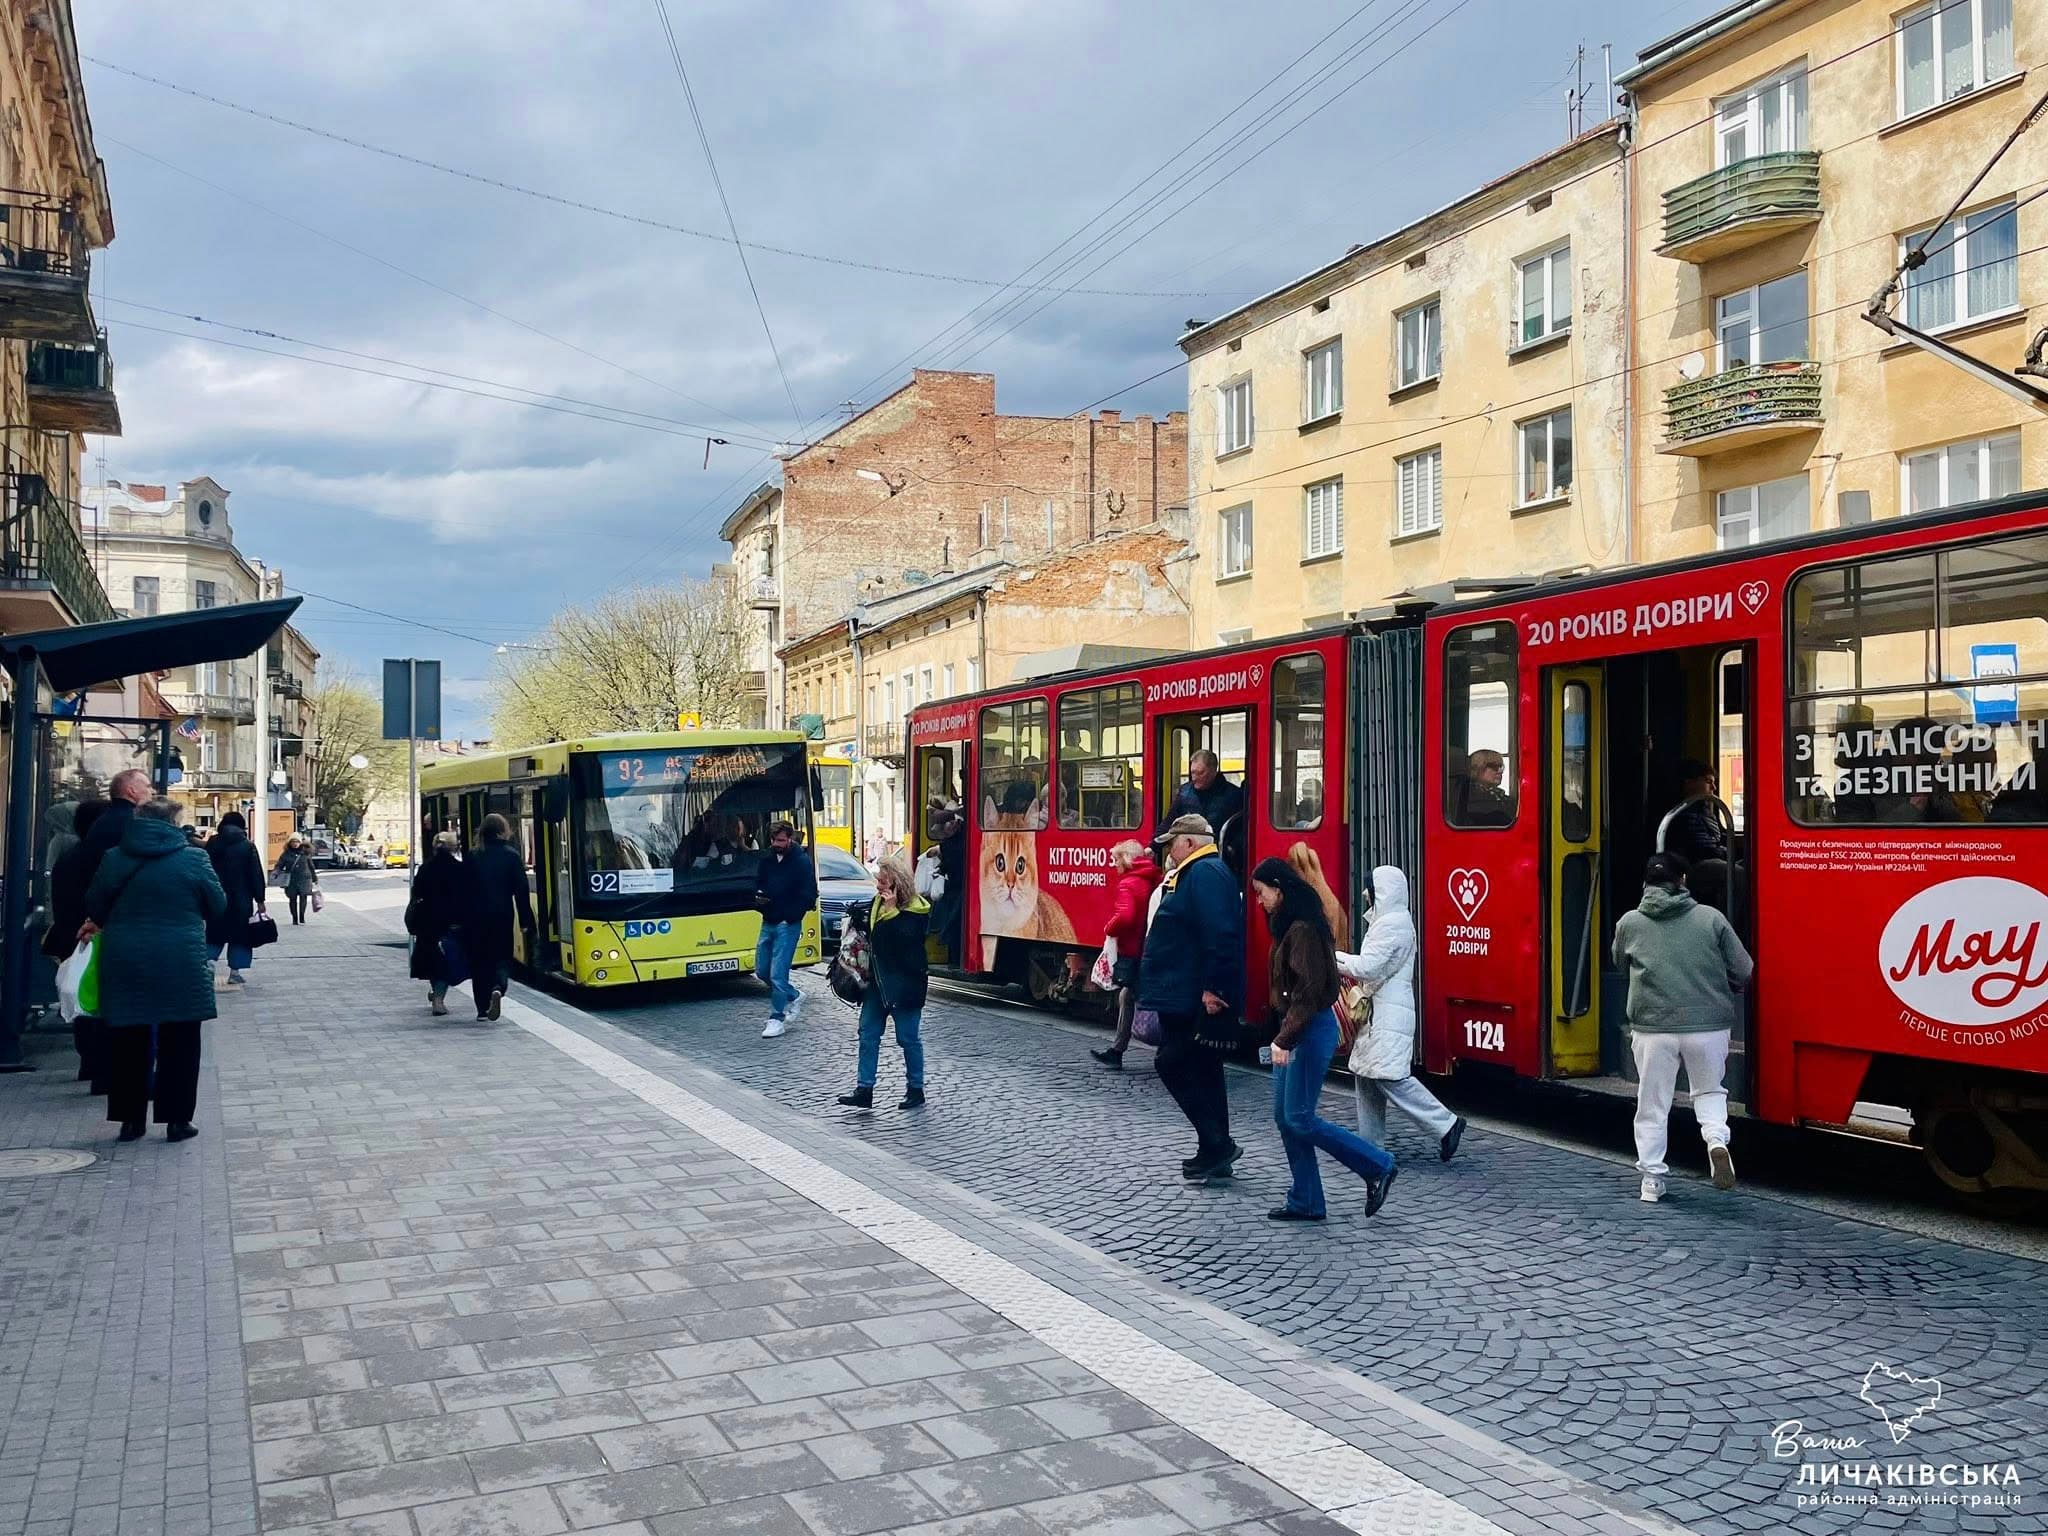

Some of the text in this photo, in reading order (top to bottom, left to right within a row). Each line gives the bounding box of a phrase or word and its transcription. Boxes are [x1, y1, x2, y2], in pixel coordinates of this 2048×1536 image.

[1527, 592, 1733, 646] 20 РОКІВ ДОВІРИ
[1147, 670, 1247, 702] 20 РОКІВ ДОВІРИ
[940, 713, 967, 734] ДОВІРИ
[618, 758, 644, 781] 92
[1795, 776, 1826, 796] та
[1779, 839, 1815, 849] Продукція
[1822, 839, 1863, 849] безпечною,
[1865, 841, 1876, 849] що
[1878, 840, 1941, 851] підтверджується
[1945, 840, 2002, 851] міжнародною
[1049, 847, 1066, 866] КІТ
[1067, 847, 1107, 867] ТОЧНО
[1780, 850, 2016, 862] сертифікацією FSSC 22000, контроль безпечності здійснюється
[1780, 861, 1818, 870] відповідно
[1829, 861, 1854, 871] Закону
[1854, 862, 1884, 871] України
[590, 873, 618, 892] 92
[1049, 871, 1107, 888] КОМУ ДОВІРЯЄ!
[1446, 925, 1491, 940] 20 РОКІВ
[1448, 940, 1488, 956] ДОВІРИ
[1889, 918, 2048, 1008] Мяу
[1463, 1019, 1505, 1052] 1124
[1899, 1010, 2048, 1046] ПЕРШЕ СЛОВО МОГО
